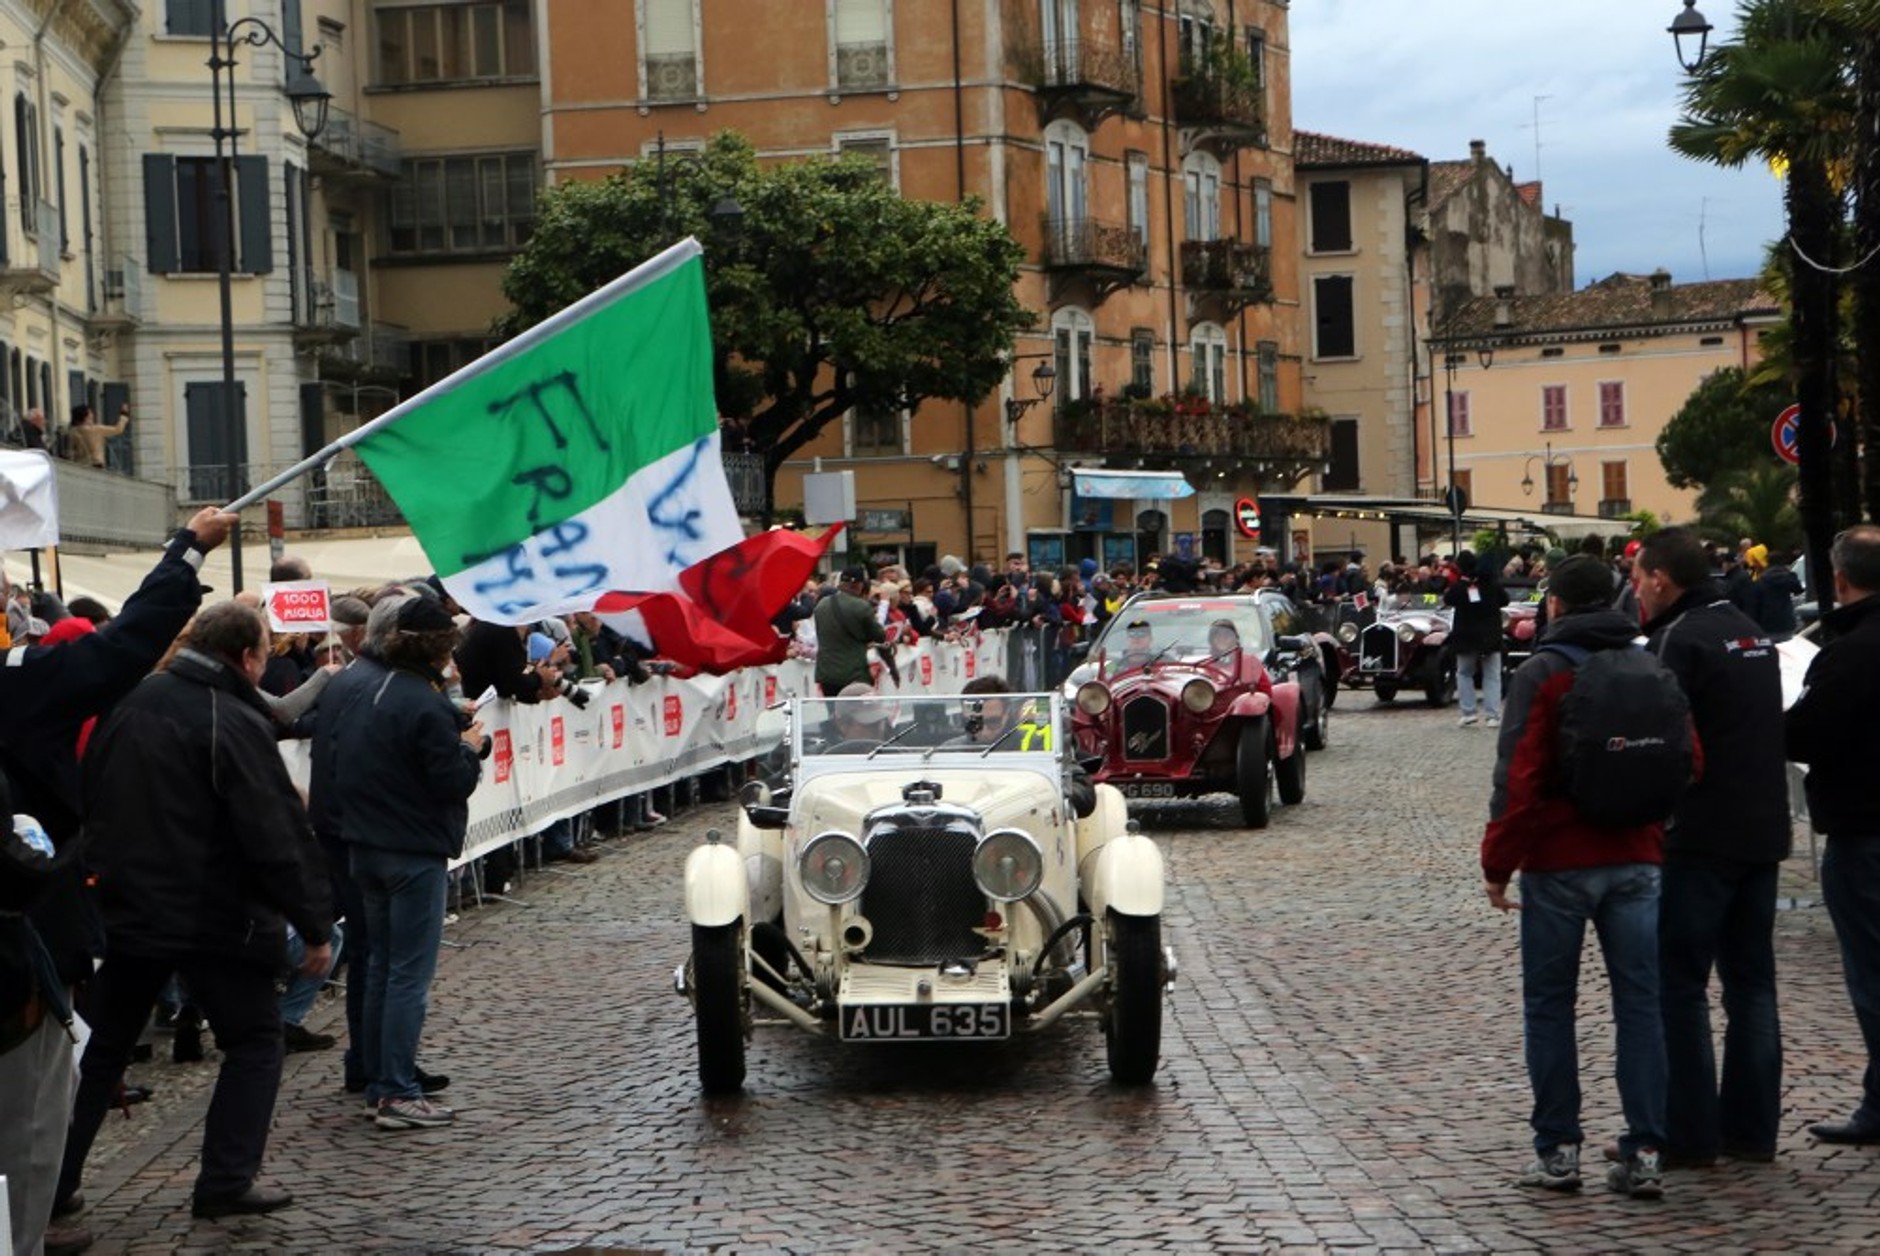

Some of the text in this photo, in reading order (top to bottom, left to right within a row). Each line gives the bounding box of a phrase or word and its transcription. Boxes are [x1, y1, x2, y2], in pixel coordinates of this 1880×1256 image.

[283, 592, 320, 604] 1000
[283, 607, 325, 619] MIGLIA
[1017, 723, 1052, 753] 71
[1141, 783, 1174, 797] 690
[850, 1006, 1001, 1038] AUL 635
